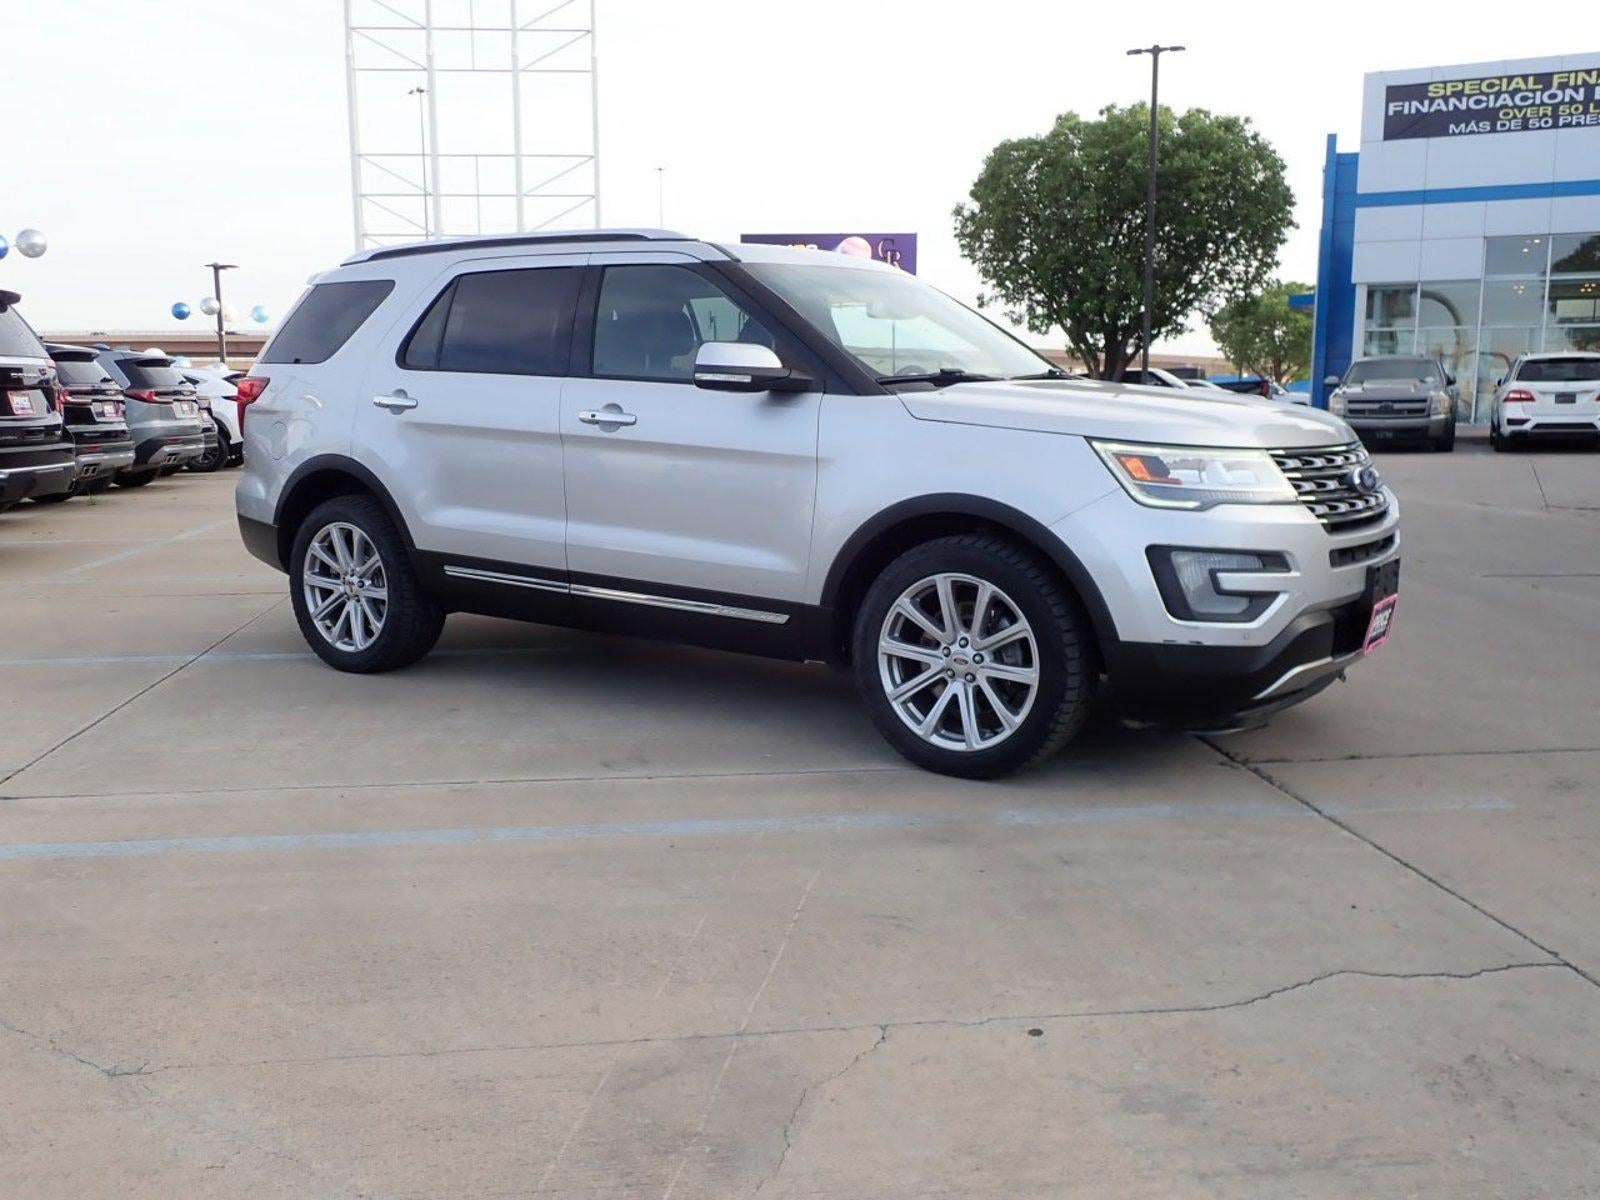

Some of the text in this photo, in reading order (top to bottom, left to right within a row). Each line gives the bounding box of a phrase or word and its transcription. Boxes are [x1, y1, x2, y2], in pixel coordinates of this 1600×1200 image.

[1427, 70, 1600, 97] SPECIAL FIN
[1387, 86, 1585, 116] FINANCIACIÓN
[1499, 105, 1552, 120] OVER
[1559, 103, 1583, 116] 50
[1449, 113, 1600, 134] MÁS DE 50 PRE
